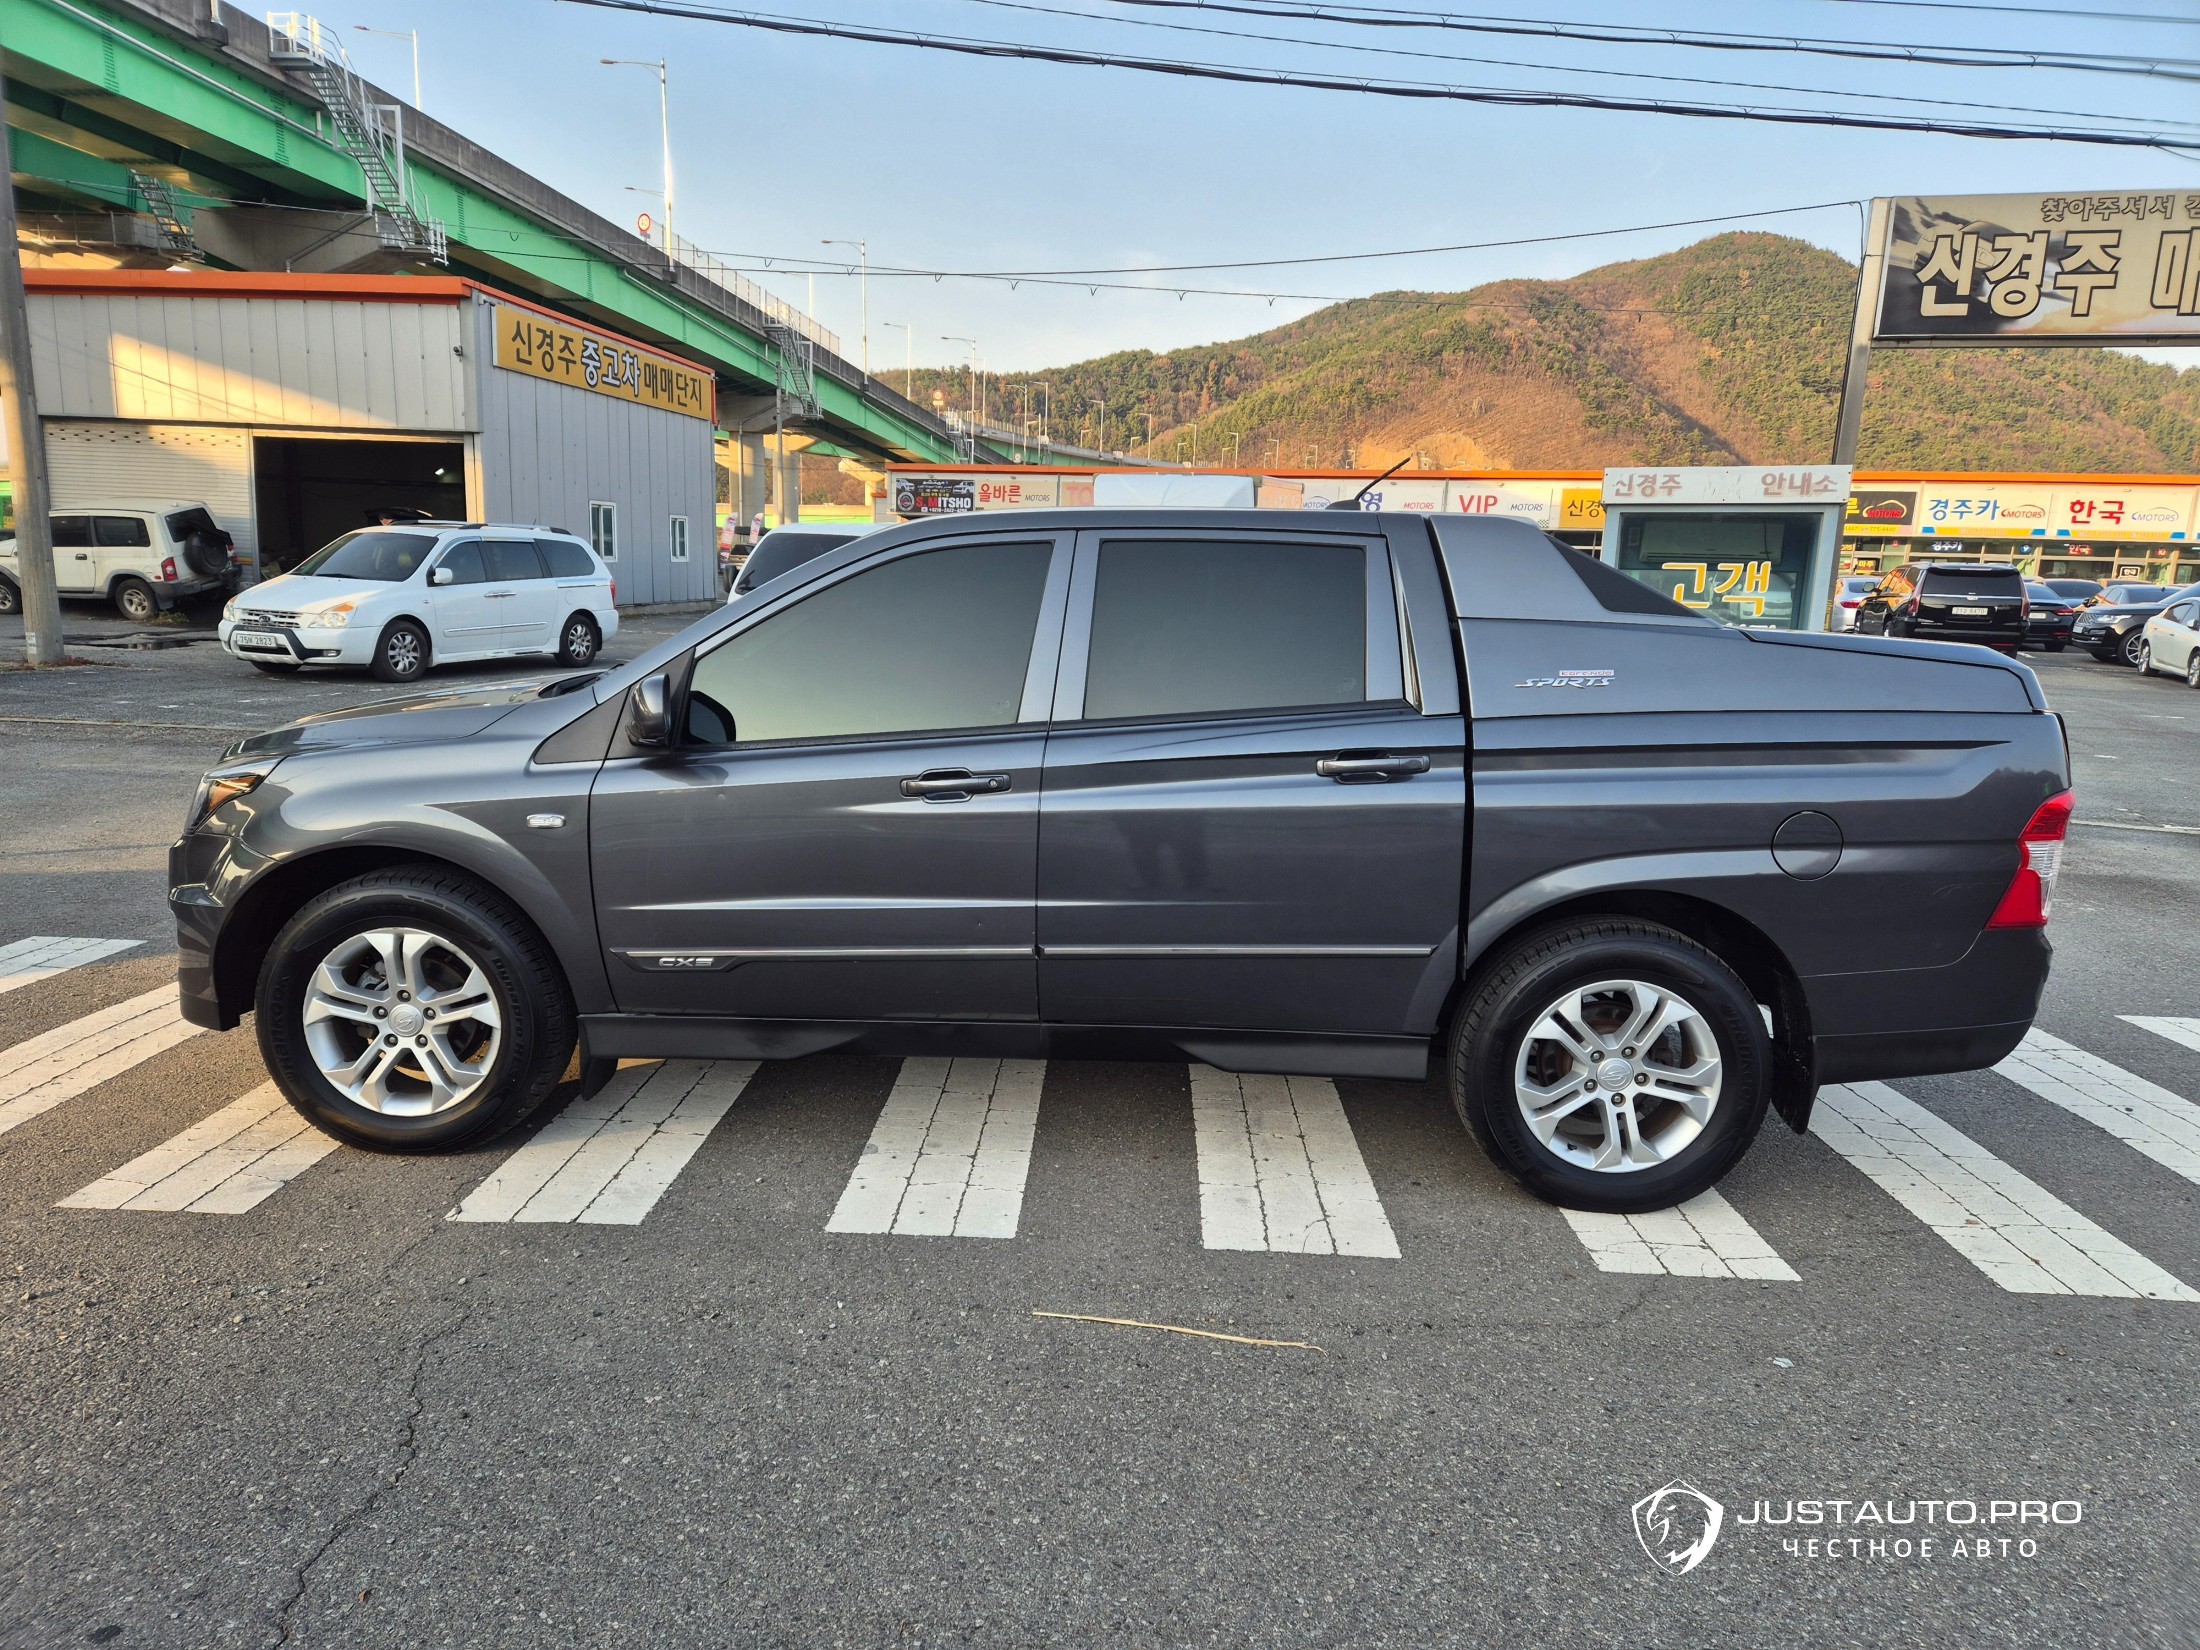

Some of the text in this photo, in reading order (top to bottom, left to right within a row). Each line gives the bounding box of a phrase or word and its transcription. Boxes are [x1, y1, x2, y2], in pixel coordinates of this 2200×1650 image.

[2042, 195, 2175, 222] 찾아주셔서
[1914, 229, 2122, 318] 신경주
[511, 320, 703, 411] 신경주 중고차 매매단지
[978, 483, 1050, 504] 올바른 MOTORS
[1613, 471, 1839, 498] 신경주 안내소
[1403, 502, 1434, 510] MOTORS
[1459, 494, 1543, 513] VIP MOTORS
[1866, 509, 1903, 519] MOTORS
[1928, 498, 2043, 521] 경주카 MOTORS
[2069, 499, 2176, 525] 한국 MOTORS
[1932, 540, 1963, 552] 경주카
[1661, 560, 1772, 617] 고객
[255, 635, 273, 645] 2823
[1515, 677, 1615, 688] SPORTS
